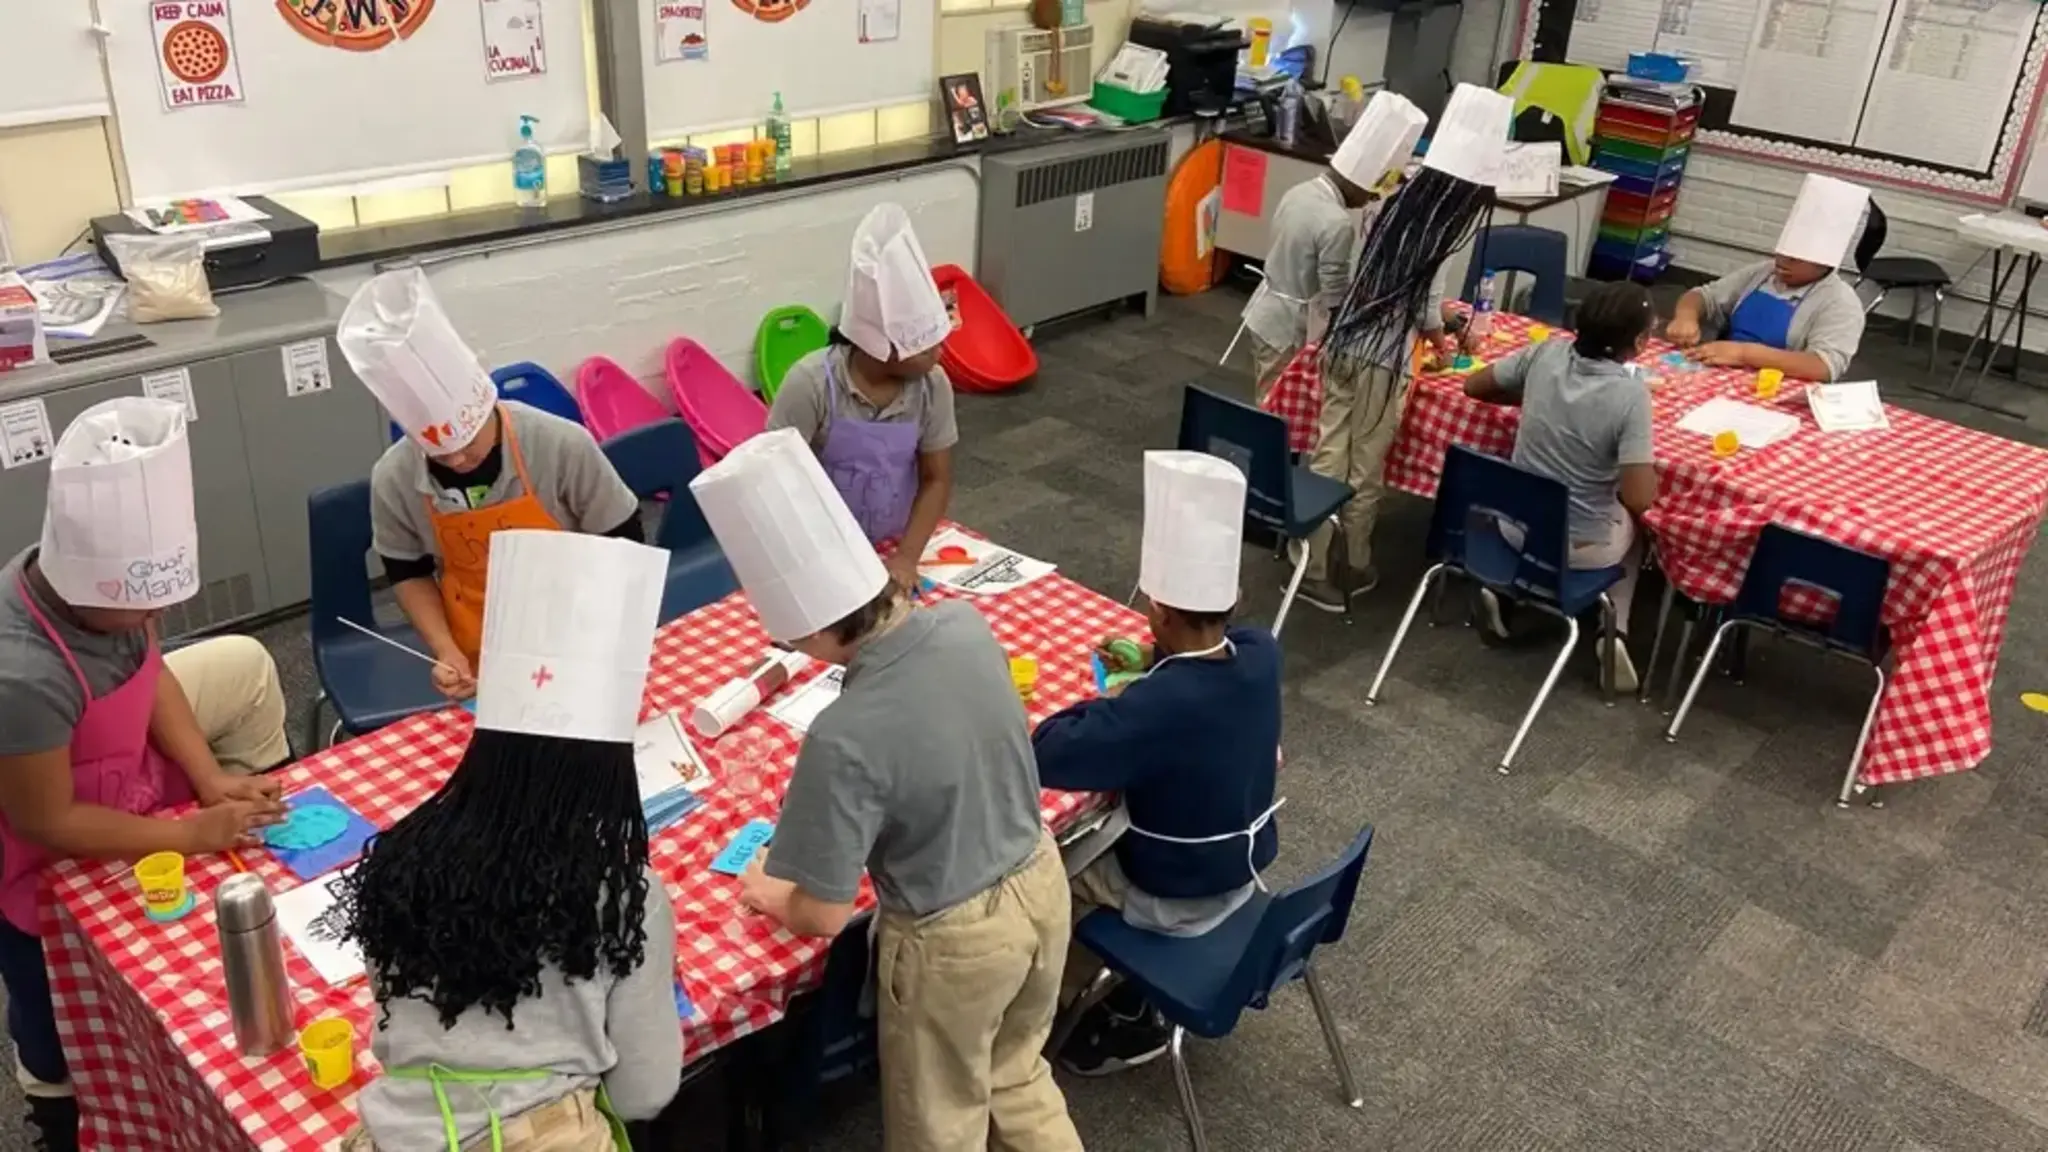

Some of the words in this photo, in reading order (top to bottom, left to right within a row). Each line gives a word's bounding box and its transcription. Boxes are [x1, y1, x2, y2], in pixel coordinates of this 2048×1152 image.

[154, 4, 182, 21] KEEP
[187, 2, 225, 18] CALM
[172, 88, 194, 104] EAT
[197, 84, 235, 100] PIZZA
